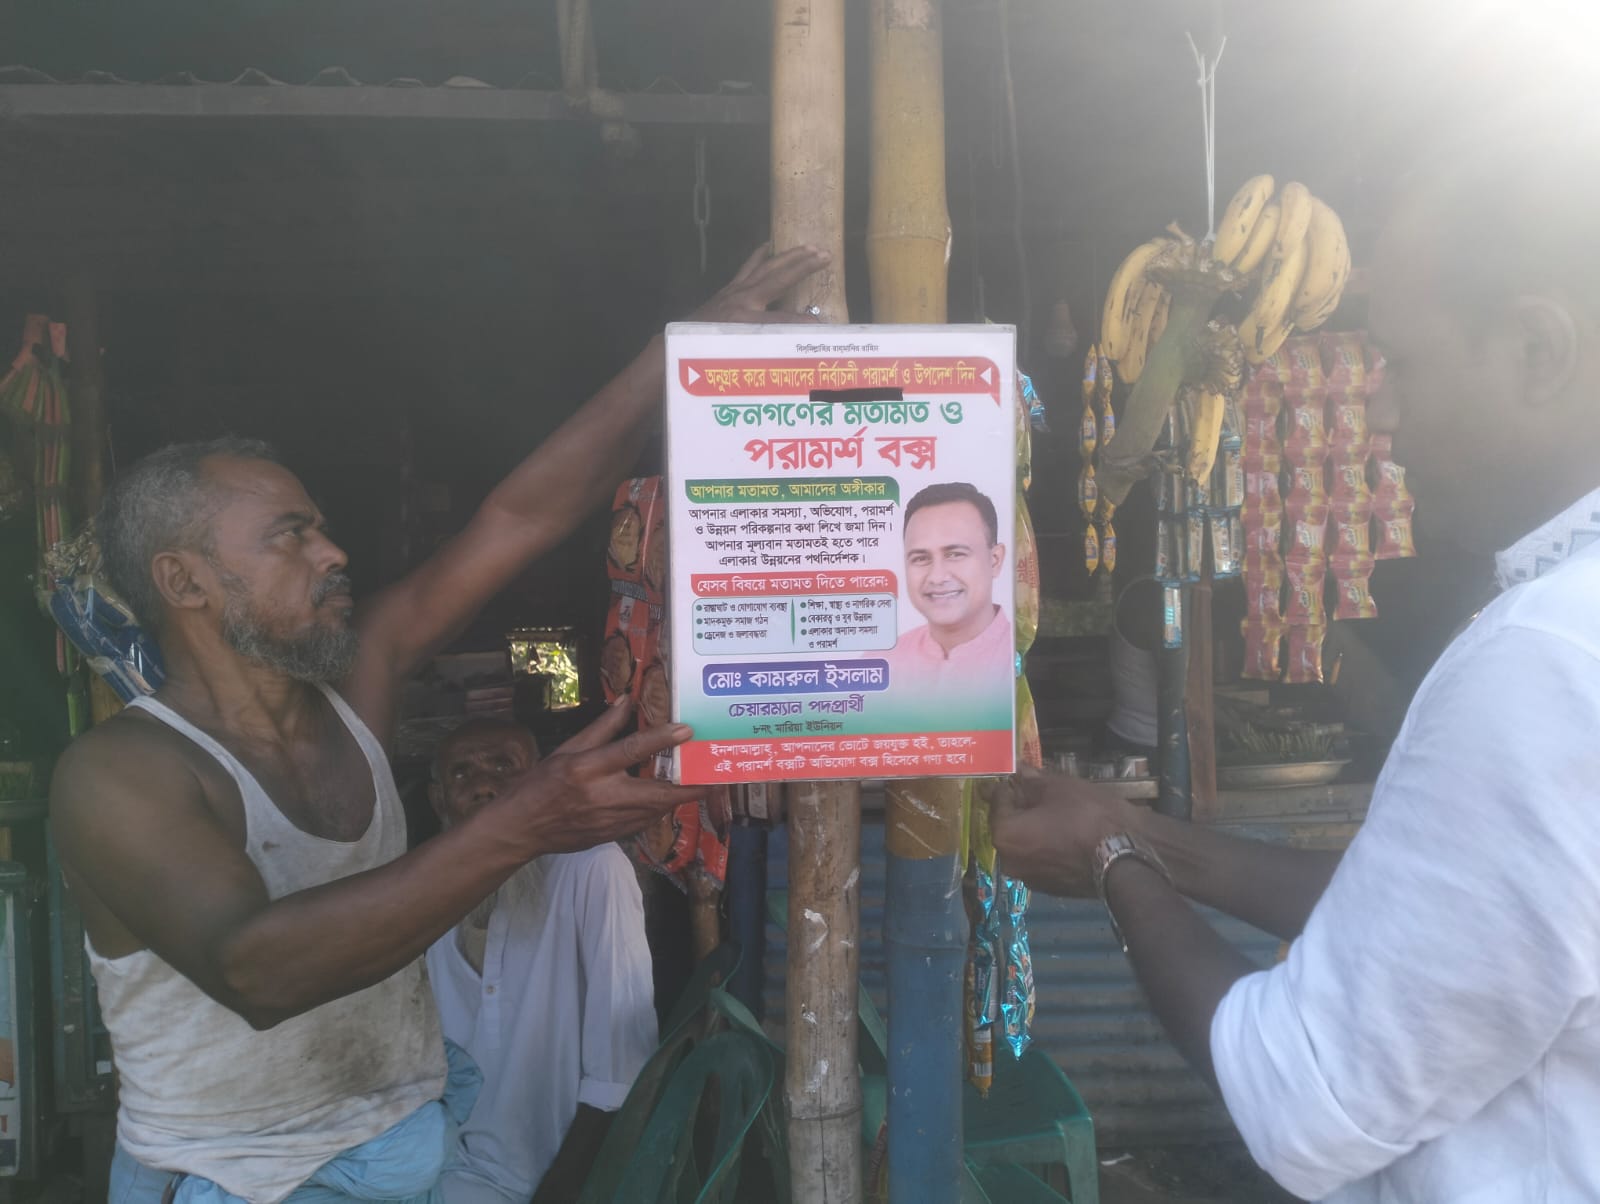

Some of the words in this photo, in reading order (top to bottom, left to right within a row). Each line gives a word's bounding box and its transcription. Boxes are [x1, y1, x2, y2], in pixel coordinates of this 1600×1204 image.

[704, 369, 740, 392] অনুগ্রহ
[742, 368, 766, 387] করে
[768, 368, 815, 387] আমাদের
[817, 360, 859, 387] নির্বাচনী
[862, 361, 899, 385] পরামর্শ
[903, 368, 911, 384] ও
[913, 363, 954, 385] উপদেশ
[956, 360, 976, 385] দিন
[711, 401, 835, 427] জনগণের
[842, 401, 930, 425] মতামত
[940, 401, 963, 425] ও
[744, 426, 869, 470] পরামর্শ
[875, 436, 937, 470] বক্স
[690, 485, 735, 499] আপনার
[788, 483, 837, 497] আমাদের
[840, 478, 886, 496] অঙ্গীকার
[688, 509, 727, 520] আপনার
[729, 508, 768, 519] এলাকার
[861, 502, 895, 517] পরামর্শ
[695, 525, 704, 535] ও
[706, 522, 737, 537] উন্নয়ন
[740, 521, 793, 535] পরিকল্পনার
[794, 522, 815, 533] কথা
[818, 519, 842, 533] লিখে
[844, 521, 865, 532] জমা
[705, 540, 743, 552] আপনার
[746, 539, 784, 553] মূল্যবান
[786, 537, 830, 550] মতামতই
[831, 538, 853, 549] হতে
[856, 537, 880, 548] পারে
[719, 556, 759, 567] এলাকার
[761, 553, 801, 567] উন্নয়নের
[697, 579, 728, 593] যেসব
[732, 576, 766, 592] বিষয়ে
[770, 577, 813, 591] মতামত
[816, 574, 846, 590] দিতে
[730, 604, 736, 612] ও
[738, 603, 768, 612] যোগাযোগ
[769, 602, 788, 613] ব্যবস্থা
[845, 600, 851, 609] ও
[852, 597, 876, 609] নাগরিক
[754, 613, 769, 625] গঠন
[835, 614, 841, 622] ও
[842, 613, 852, 625] যুব
[853, 611, 873, 623] উন্নয়ন
[728, 631, 734, 639] ও
[808, 627, 833, 636] এলাকার
[808, 641, 814, 649] ও
[816, 638, 838, 649] পরামর্শ
[707, 671, 742, 690] মোঃ
[748, 669, 819, 688] কামরুল
[825, 663, 884, 689] ইসলাম
[728, 701, 802, 718] চেয়ারম্যান
[808, 693, 865, 715] পদপ্রার্থী
[805, 719, 844, 732] ইউনিয়ন
[781, 741, 836, 753] আপনাদের
[839, 738, 869, 751] ভোটে
[872, 738, 911, 752] জয়যুক্ত
[714, 759, 733, 773] এই
[736, 755, 773, 771] পরামর্শ
[776, 755, 806, 770] বক্সটি
[810, 755, 856, 769] অভিযোগ
[859, 756, 880, 768] বক্স
